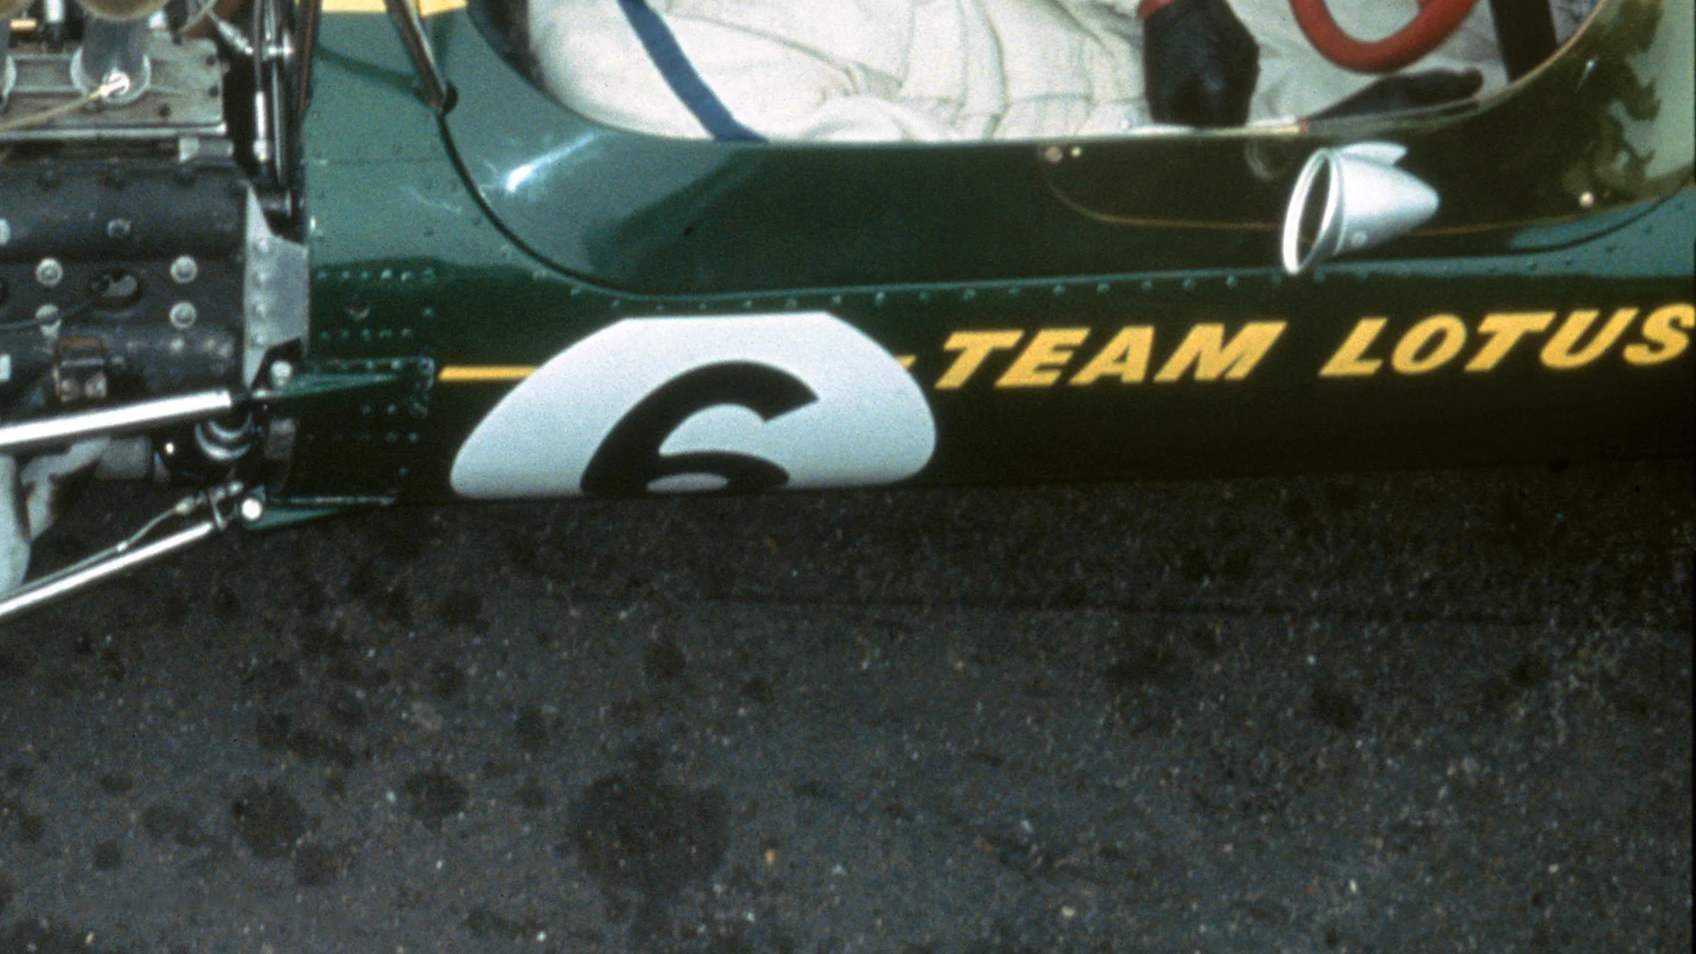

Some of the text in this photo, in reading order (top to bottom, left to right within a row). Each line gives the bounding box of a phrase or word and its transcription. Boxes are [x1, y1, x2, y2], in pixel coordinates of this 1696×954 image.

[934, 302, 1695, 389] TEAM LOTUS
[580, 359, 819, 494] 6
